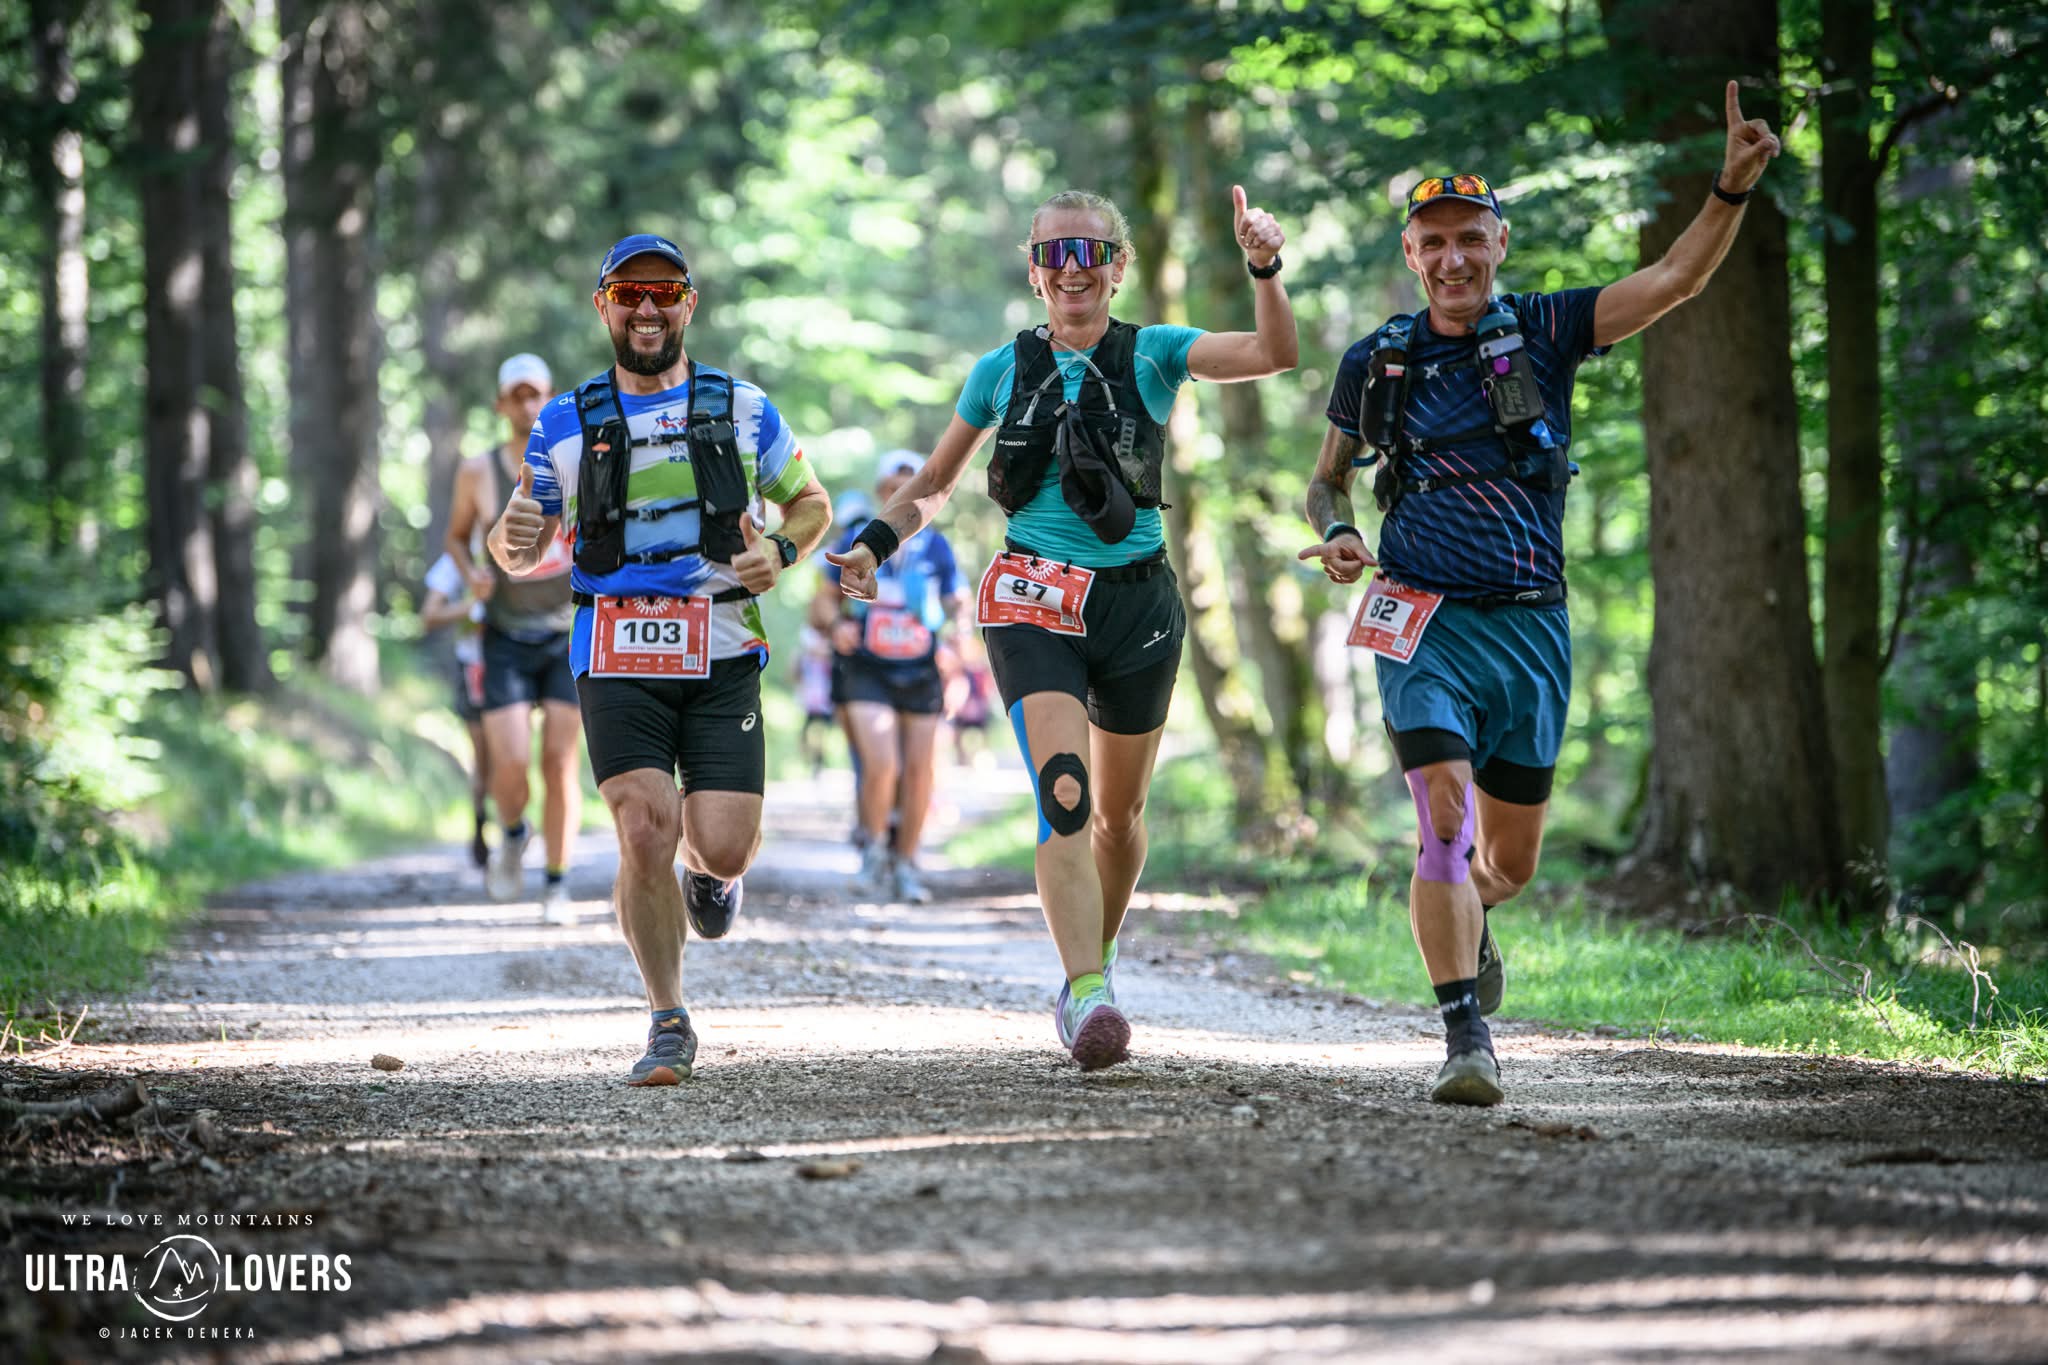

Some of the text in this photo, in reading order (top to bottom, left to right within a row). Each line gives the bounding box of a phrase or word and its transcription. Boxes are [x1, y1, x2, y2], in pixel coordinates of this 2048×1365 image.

[1011, 578, 1048, 602] 87
[1370, 596, 1398, 622] 82
[623, 621, 682, 644] 103
